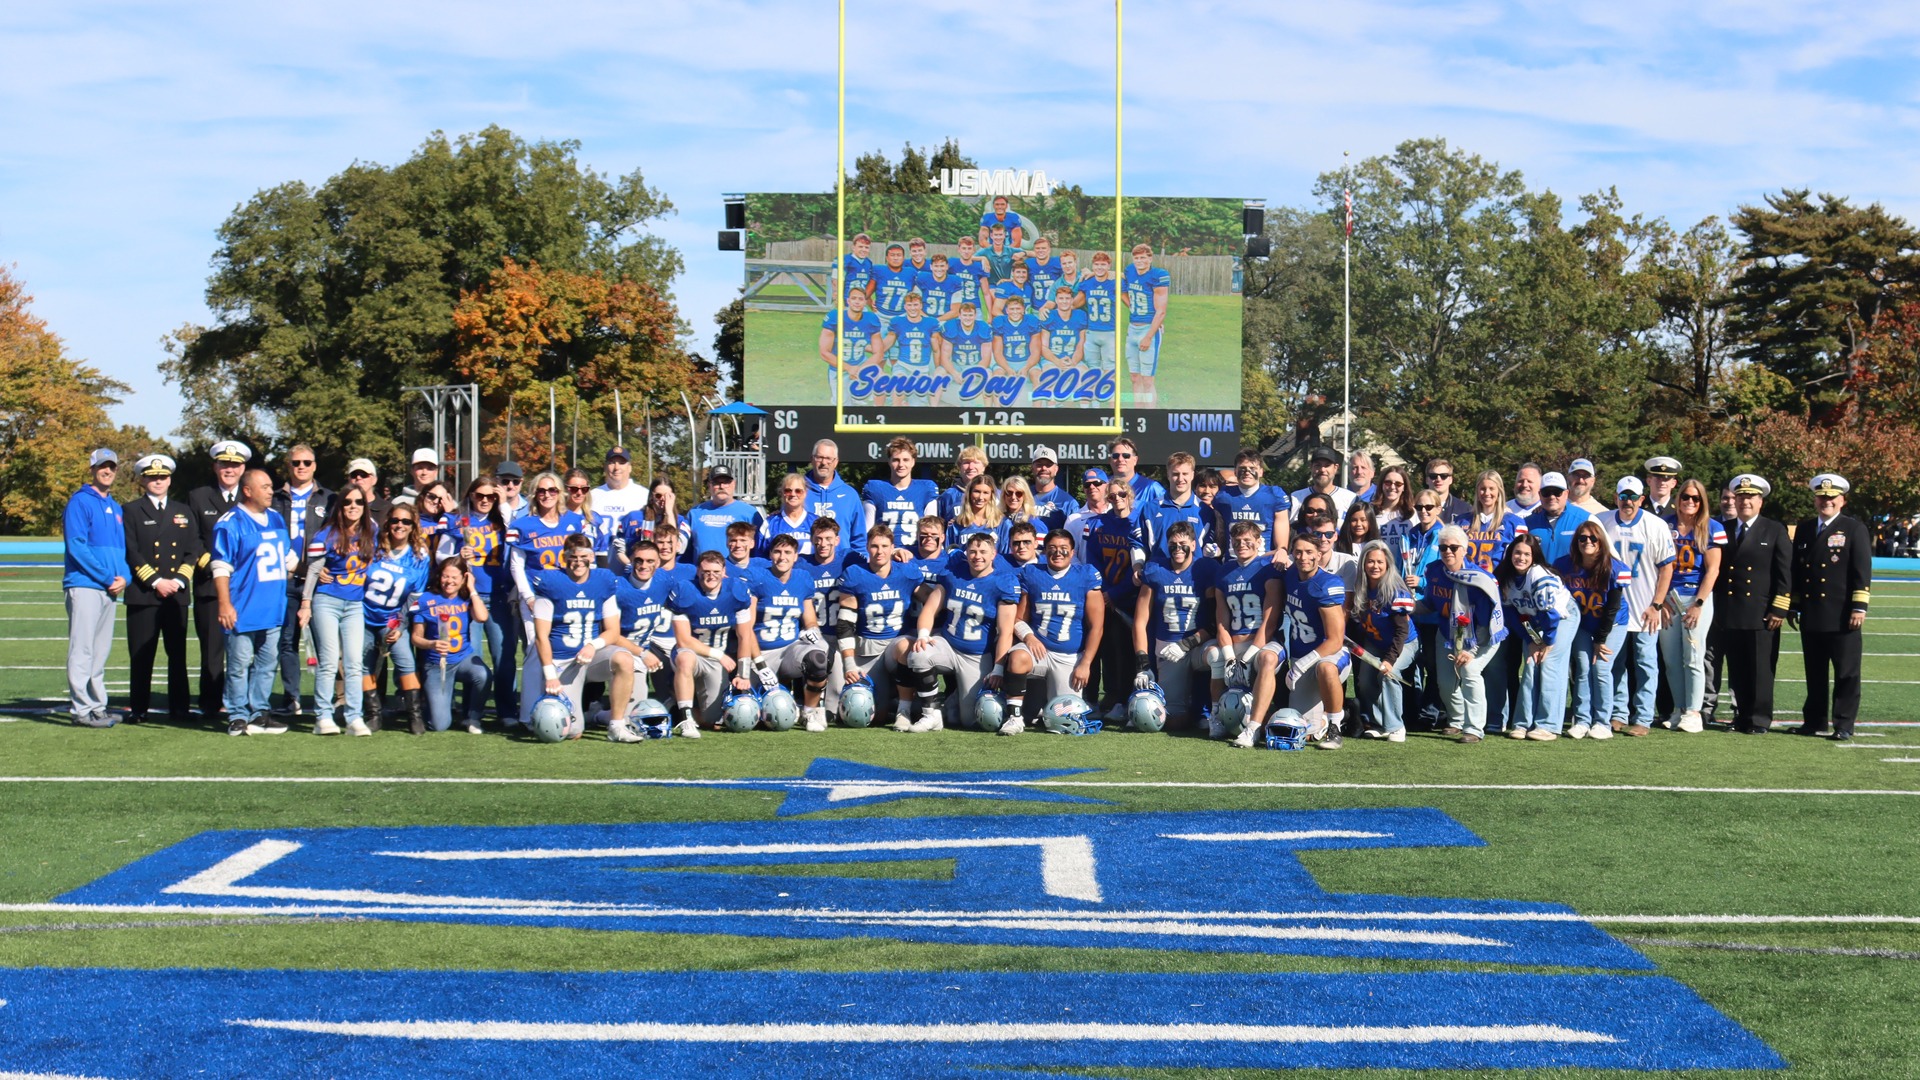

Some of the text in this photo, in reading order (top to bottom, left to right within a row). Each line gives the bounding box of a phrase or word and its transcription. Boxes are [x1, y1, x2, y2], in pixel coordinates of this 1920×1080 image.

[940, 168, 1049, 196] USMMA
[882, 287, 908, 312] 77
[926, 297, 946, 315] 31
[1087, 297, 1112, 322] 33
[909, 339, 922, 363] 8
[1005, 342, 1026, 358] 14
[1051, 336, 1077, 356] 64
[849, 364, 1116, 406] Senior Day 2026
[774, 410, 798, 429] SC
[958, 411, 1025, 436] 17:36
[1137, 418, 1147, 433] 3
[1167, 413, 1235, 433] USMMA
[777, 433, 791, 454] 0
[868, 442, 882, 459] Q:
[916, 443, 953, 459] OWN:
[982, 443, 1023, 459] TOGO:
[1058, 444, 1094, 459] BALL:
[1199, 437, 1212, 458] 0
[887, 502, 914, 510] USMMA
[1232, 511, 1260, 520] USMMA
[882, 511, 919, 546] 79
[1380, 523, 1409, 536] EAT
[1468, 531, 1502, 540] SMMA
[533, 535, 567, 549] USMM
[1097, 533, 1129, 547] USMM
[256, 541, 286, 582] 21
[364, 569, 407, 607] 21
[871, 590, 900, 601] USMMA
[955, 588, 983, 603] USMMA
[1041, 592, 1071, 601] USMMA
[1164, 585, 1193, 594] USMMA
[429, 603, 468, 617] USMM
[566, 599, 595, 609] USMMA
[772, 596, 799, 606] USMMA
[699, 616, 729, 625] USMMA
[865, 600, 904, 633] 64
[947, 598, 985, 640] 72
[1035, 603, 1076, 642] 77
[448, 616, 463, 653] 8
[562, 611, 595, 648] 31
